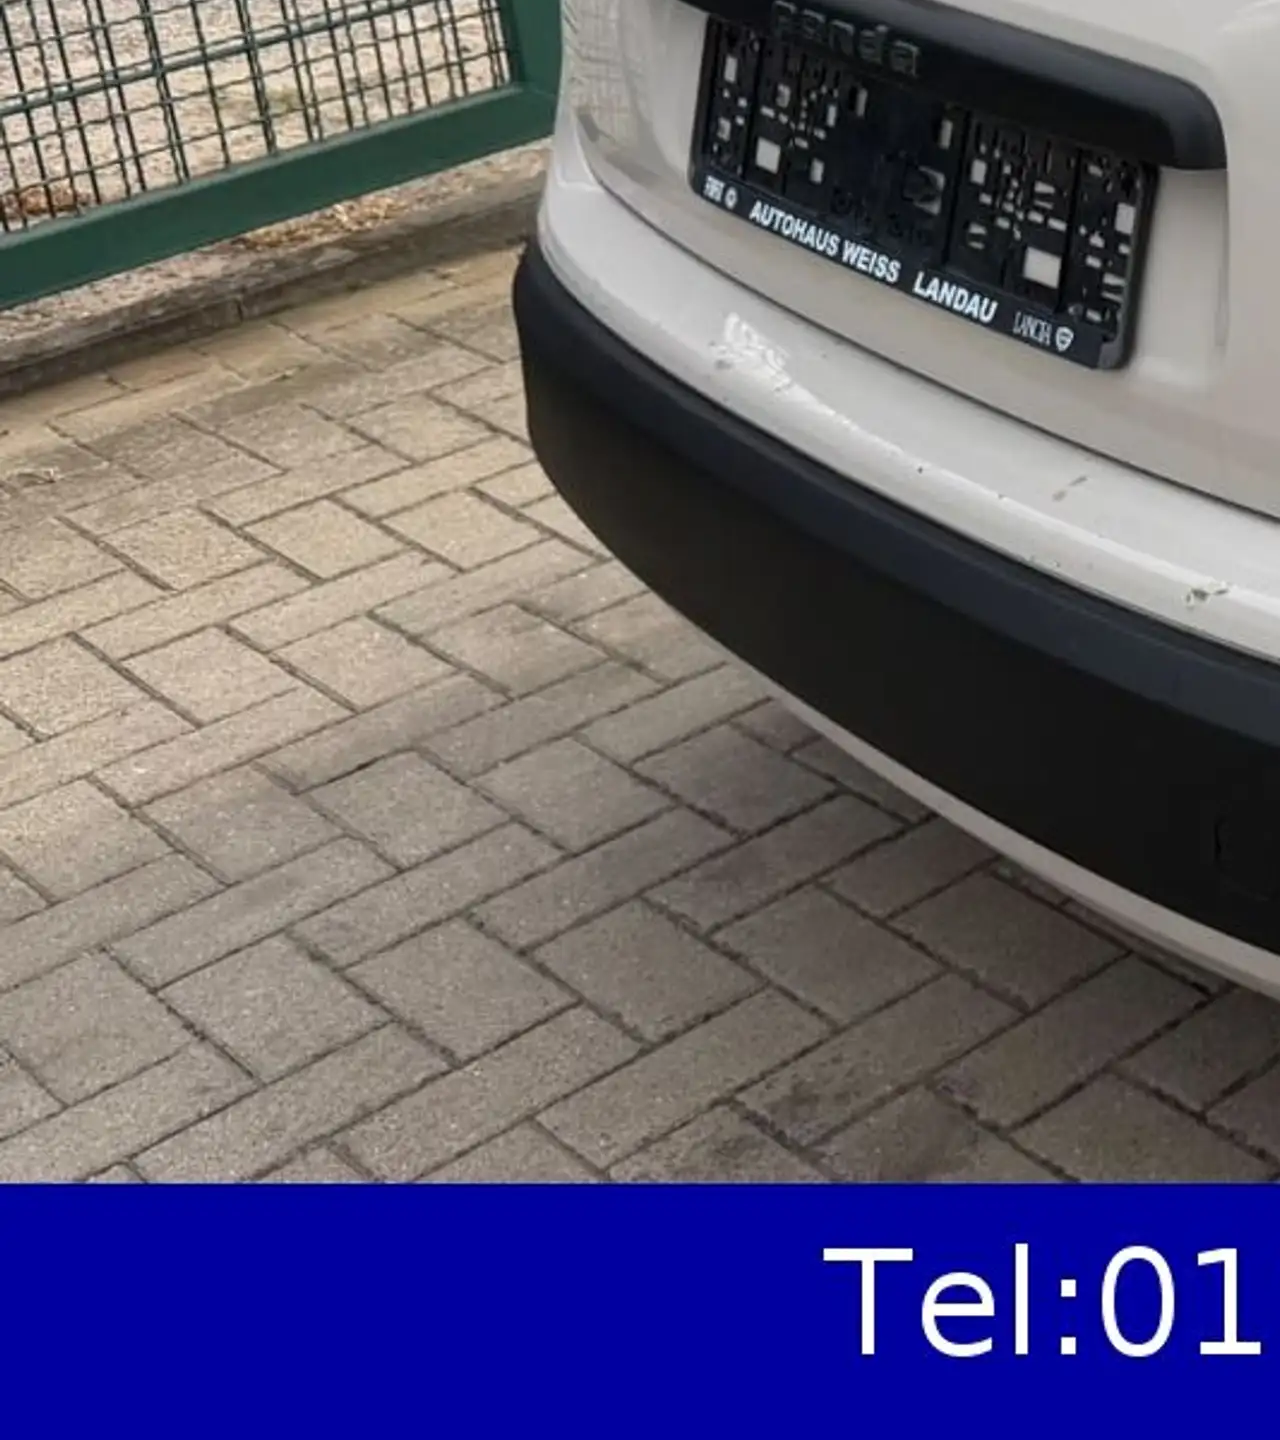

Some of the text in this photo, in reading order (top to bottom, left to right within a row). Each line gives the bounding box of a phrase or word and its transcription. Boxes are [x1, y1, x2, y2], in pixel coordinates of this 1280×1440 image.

[749, 200, 841, 257] AUTOHAUS
[842, 238, 902, 284] WEISS
[913, 270, 999, 324] LANDAU
